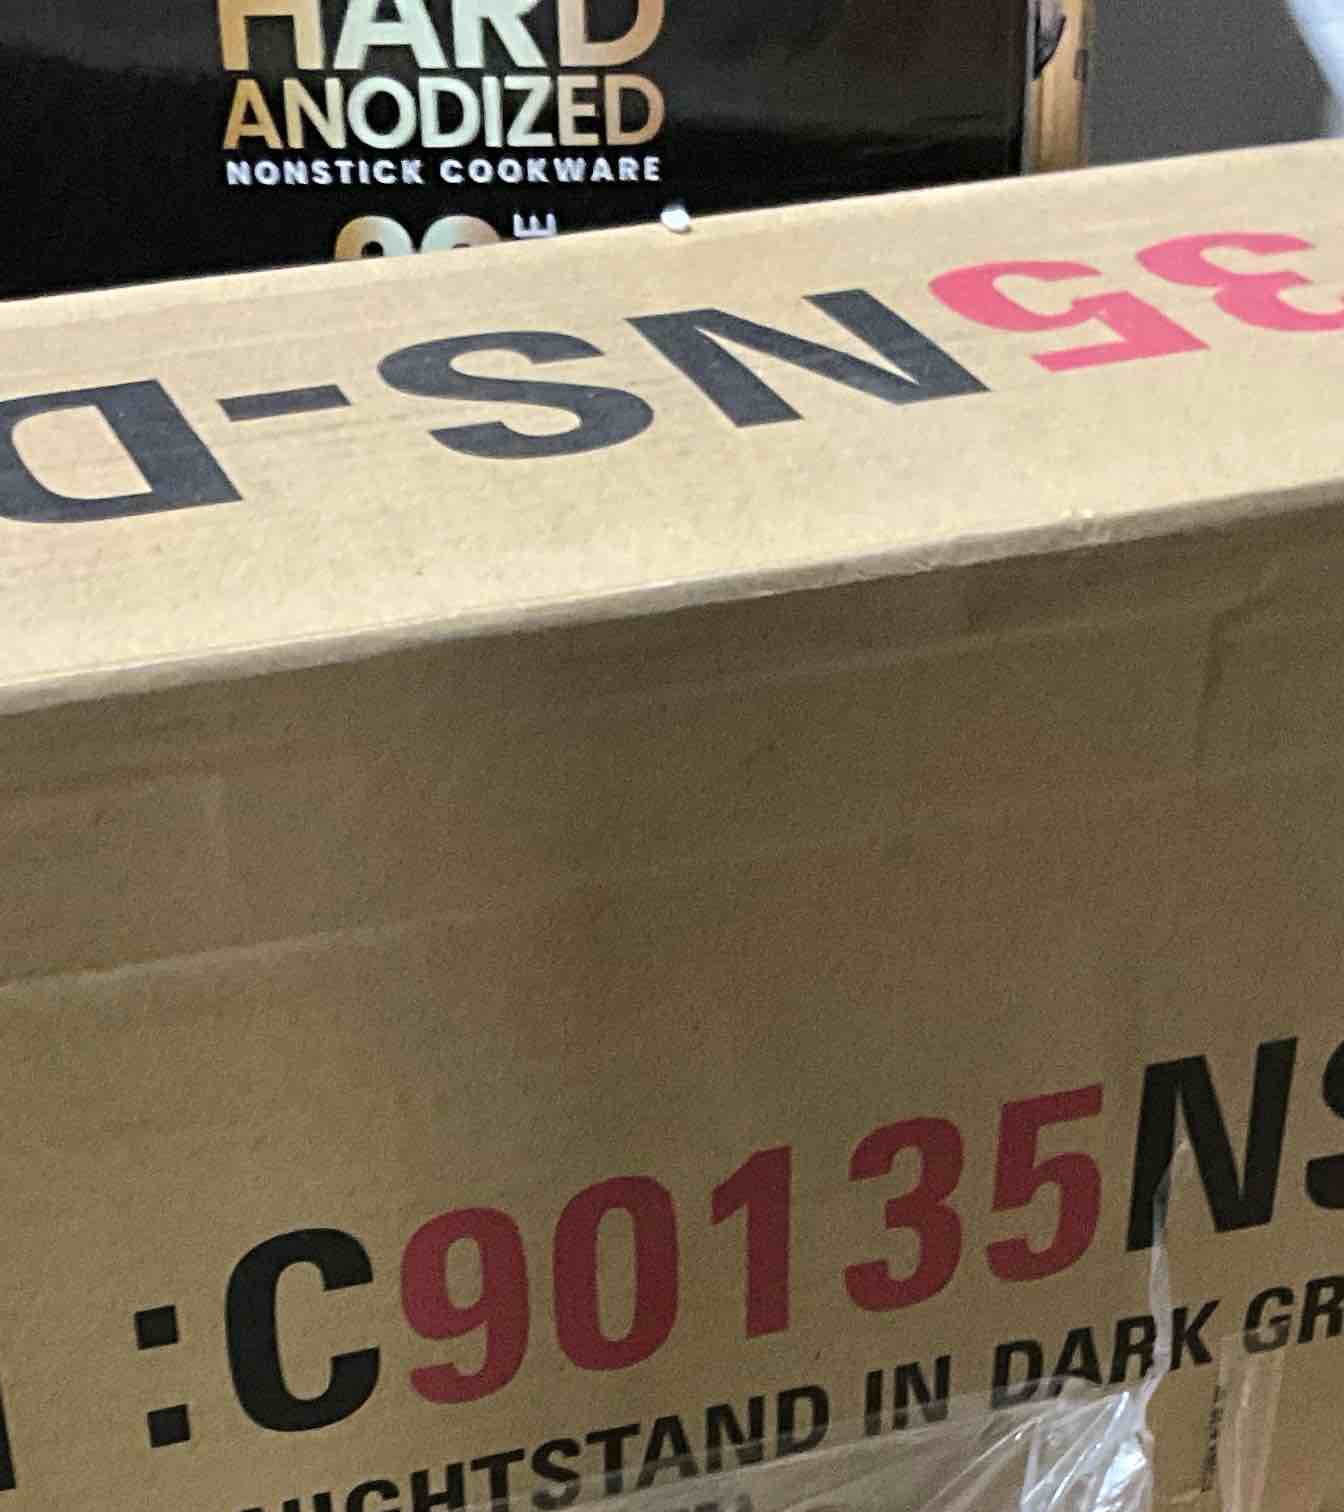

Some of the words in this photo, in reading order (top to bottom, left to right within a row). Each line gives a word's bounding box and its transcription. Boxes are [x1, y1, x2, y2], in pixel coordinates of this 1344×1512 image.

[222, 75, 665, 151] ANODIZED
[226, 158, 424, 186] NONSTICK
[440, 156, 663, 184] COOKWARE
[863, 1354, 953, 1437] IN
[989, 1298, 1223, 1410] DARK
